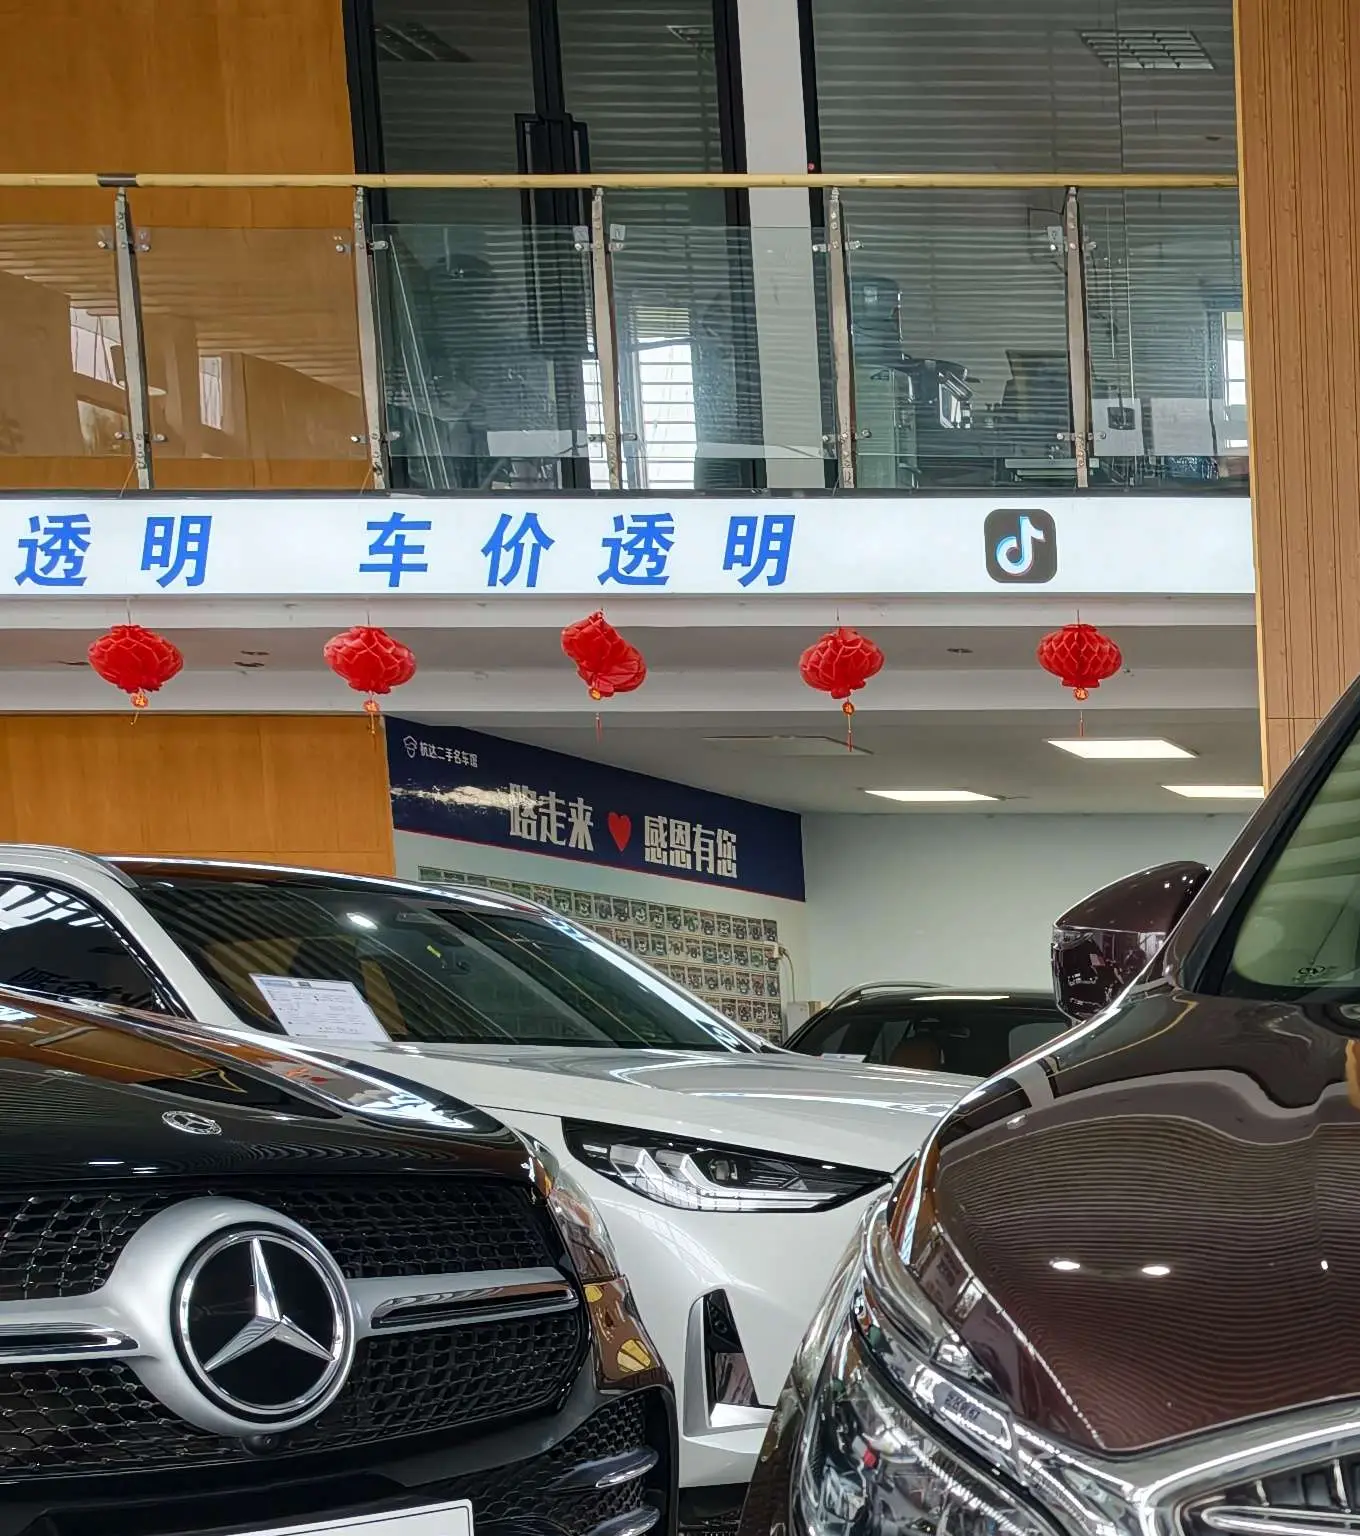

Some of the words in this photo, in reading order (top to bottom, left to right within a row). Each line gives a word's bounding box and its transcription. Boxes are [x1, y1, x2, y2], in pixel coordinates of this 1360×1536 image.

[14, 512, 213, 588] 透明
[359, 511, 797, 588] 车价透明
[487, 783, 594, 852] 路走来
[643, 815, 739, 879] 感恩有您
